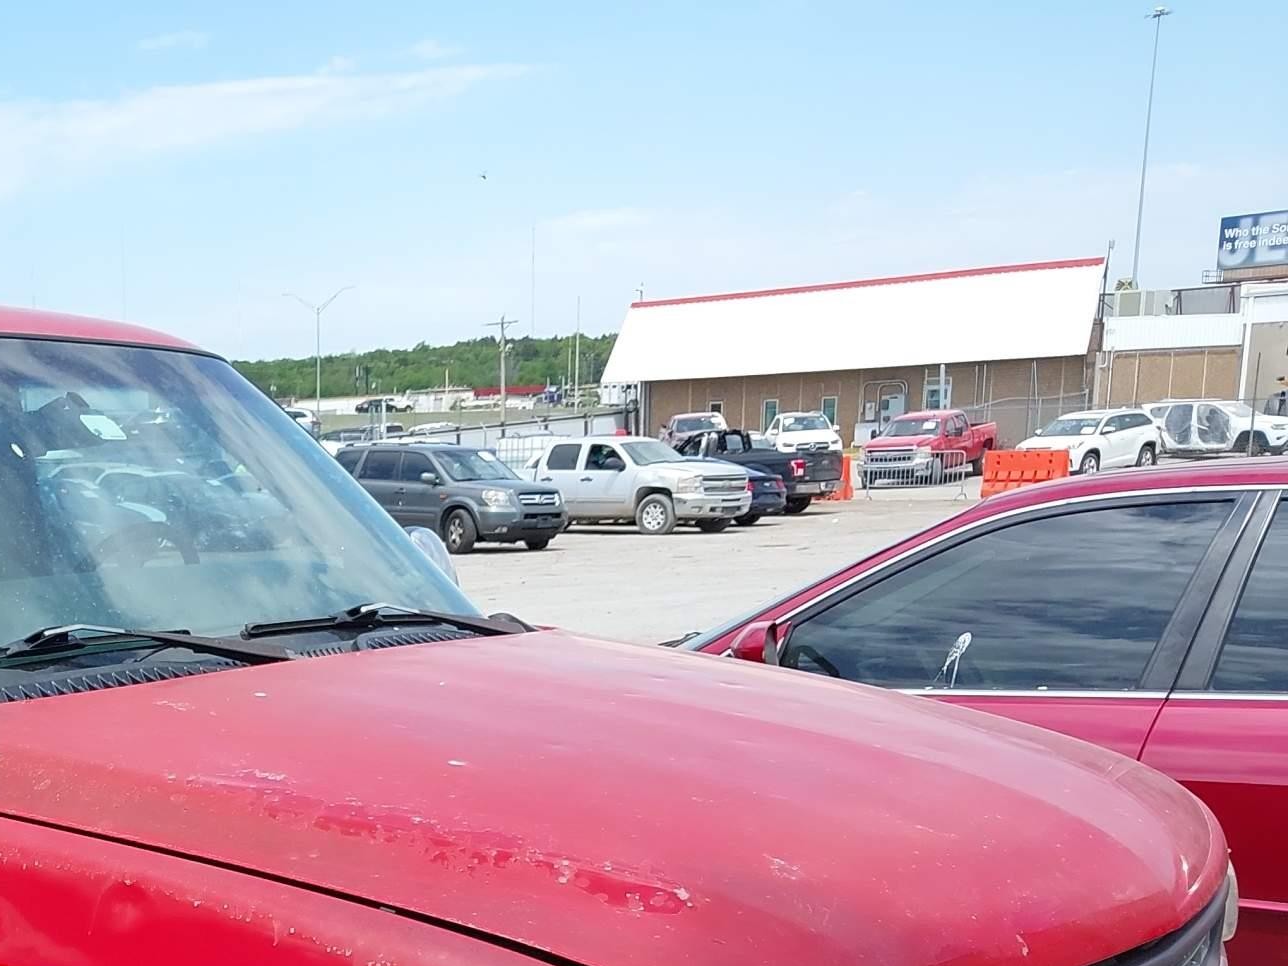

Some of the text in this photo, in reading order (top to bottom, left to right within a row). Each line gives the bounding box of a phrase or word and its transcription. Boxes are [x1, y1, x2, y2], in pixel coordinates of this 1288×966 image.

[1224, 228, 1249, 239] Who
[1252, 225, 1270, 236] the
[1234, 239, 1257, 249] free
